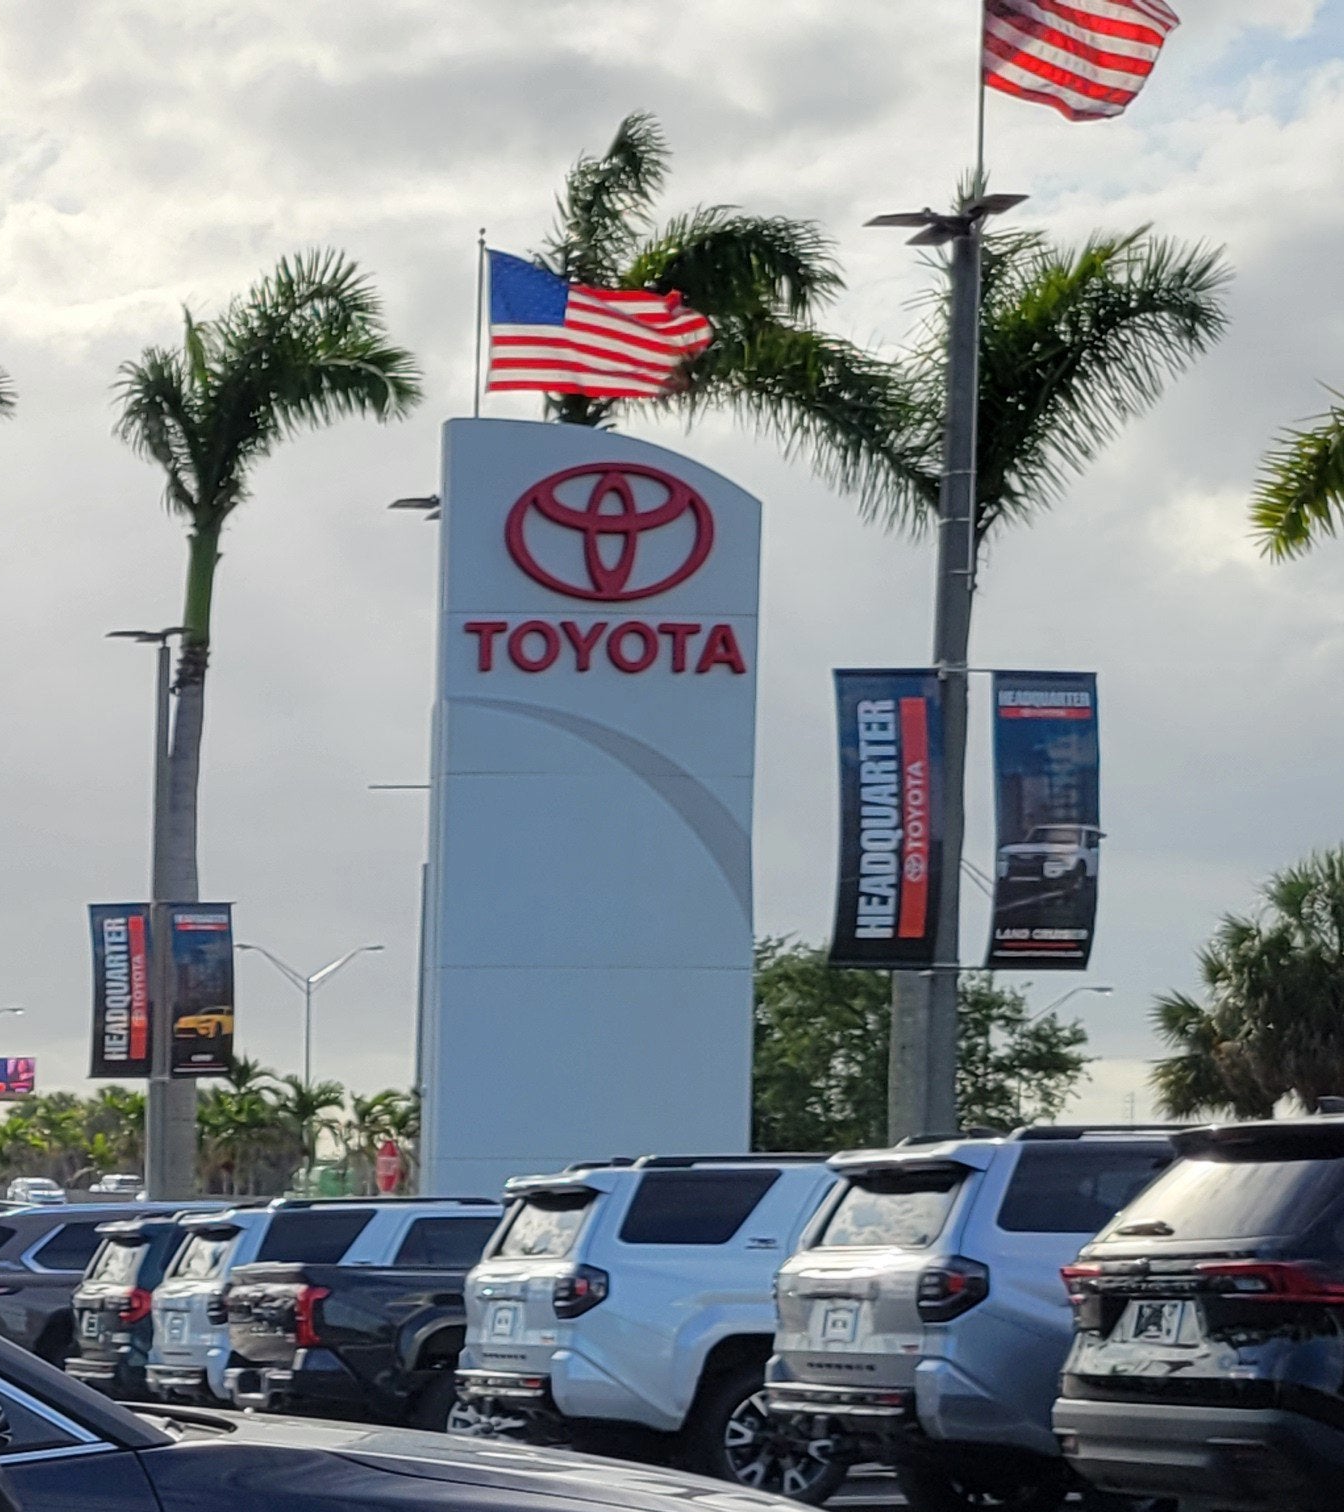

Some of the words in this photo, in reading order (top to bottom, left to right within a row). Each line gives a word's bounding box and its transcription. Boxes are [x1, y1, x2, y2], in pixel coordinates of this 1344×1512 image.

[464, 620, 747, 674] TOYOTA
[855, 699, 903, 939] HEADQUARTER
[907, 761, 923, 851] TOYOTA
[103, 916, 130, 1061] HEADQUARTER
